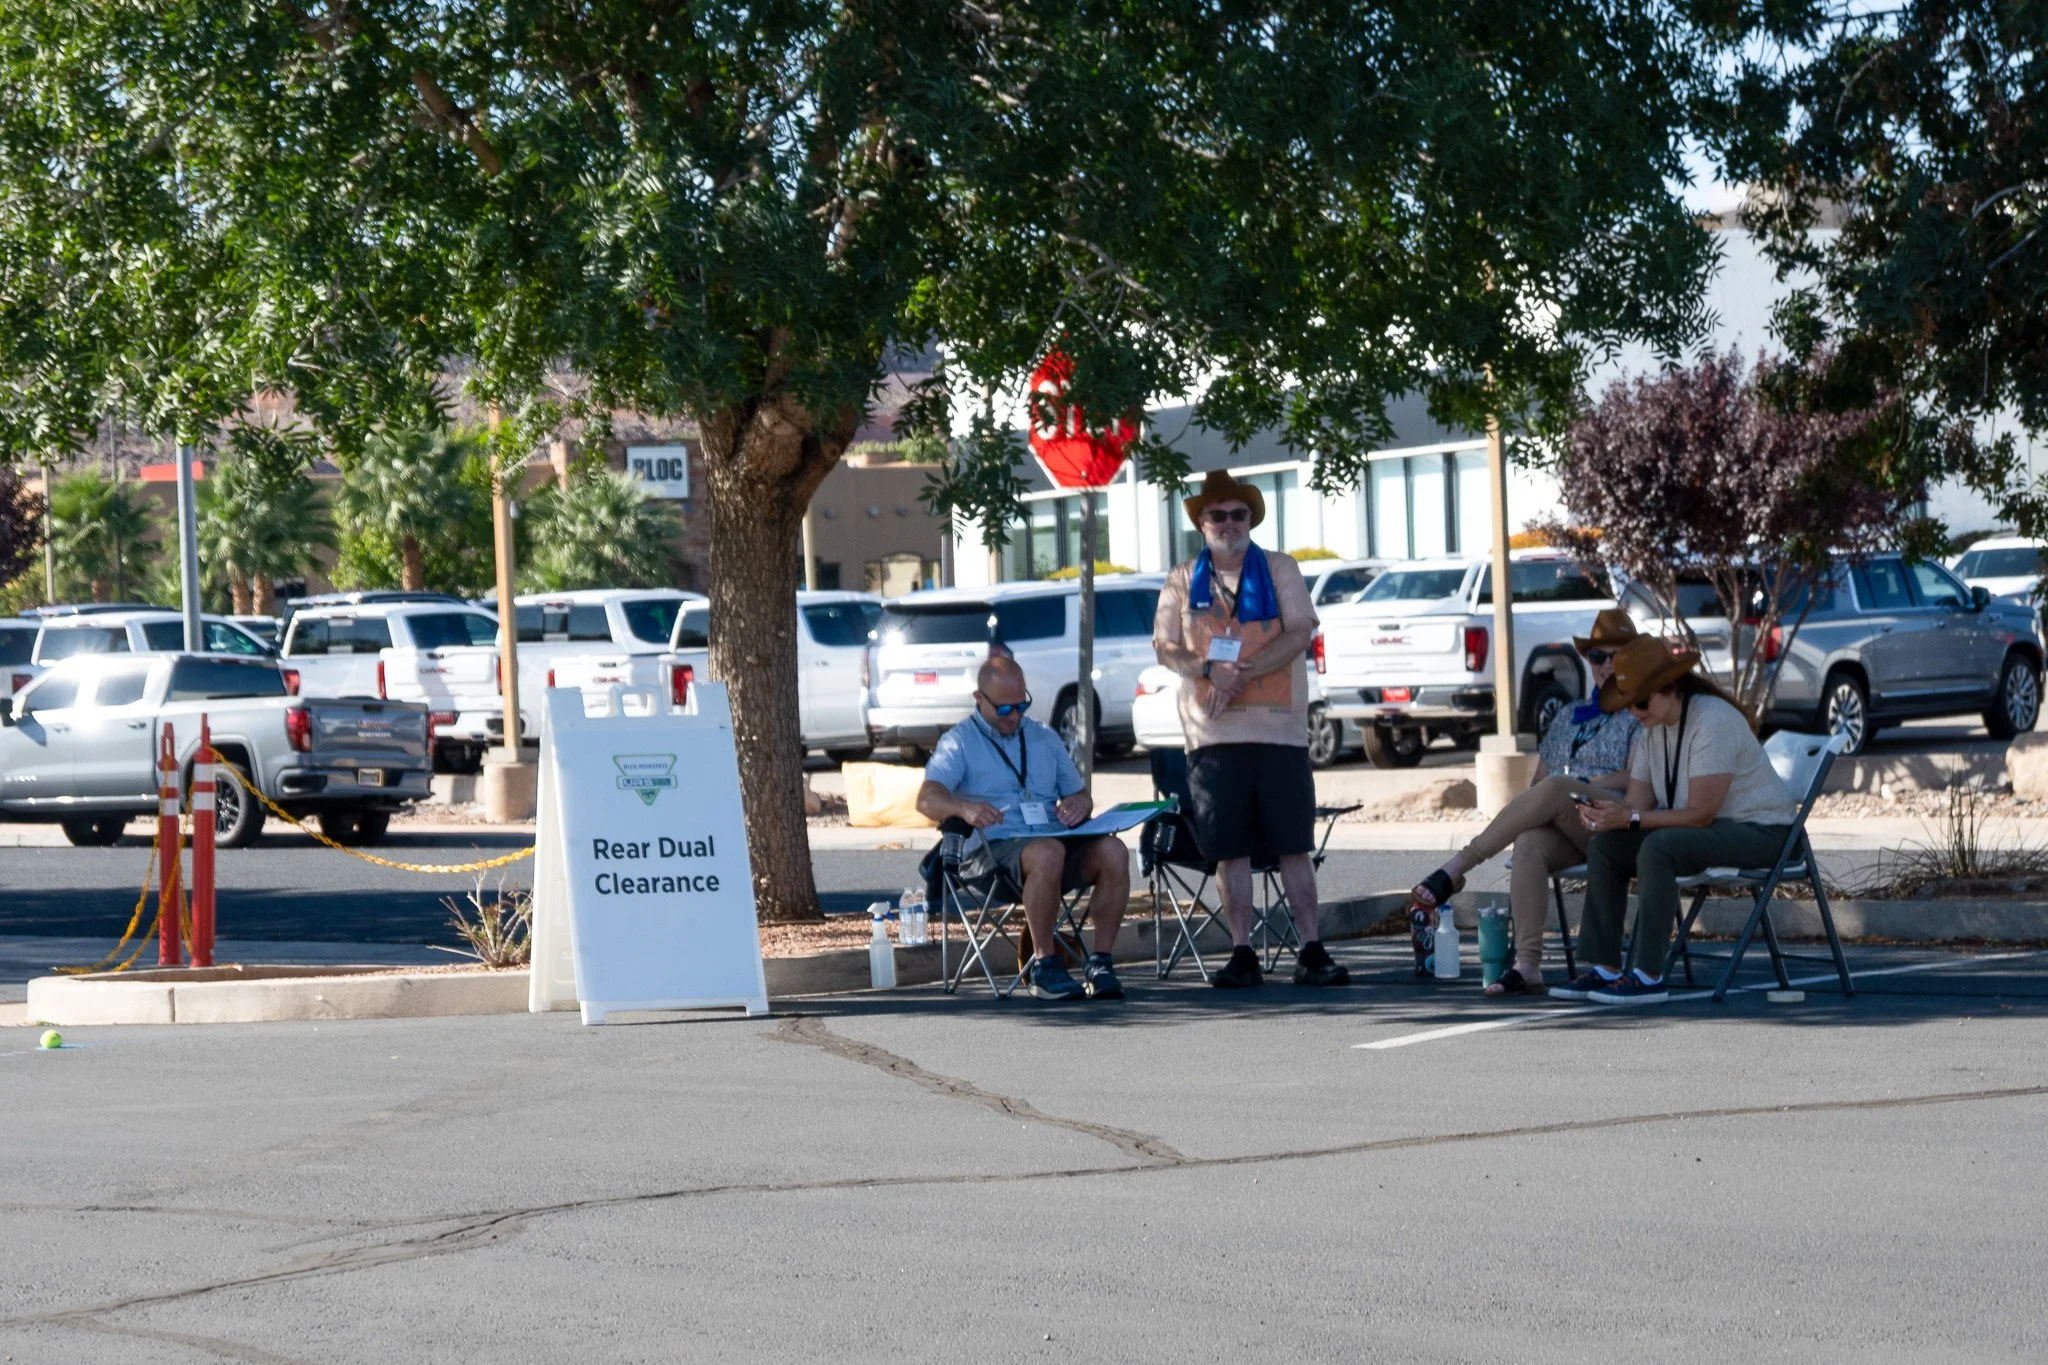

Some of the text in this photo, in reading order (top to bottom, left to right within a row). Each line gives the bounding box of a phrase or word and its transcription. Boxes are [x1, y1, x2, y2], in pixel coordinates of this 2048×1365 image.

[592, 835, 715, 860] Rear Dual
[594, 872, 720, 895] Clearance
